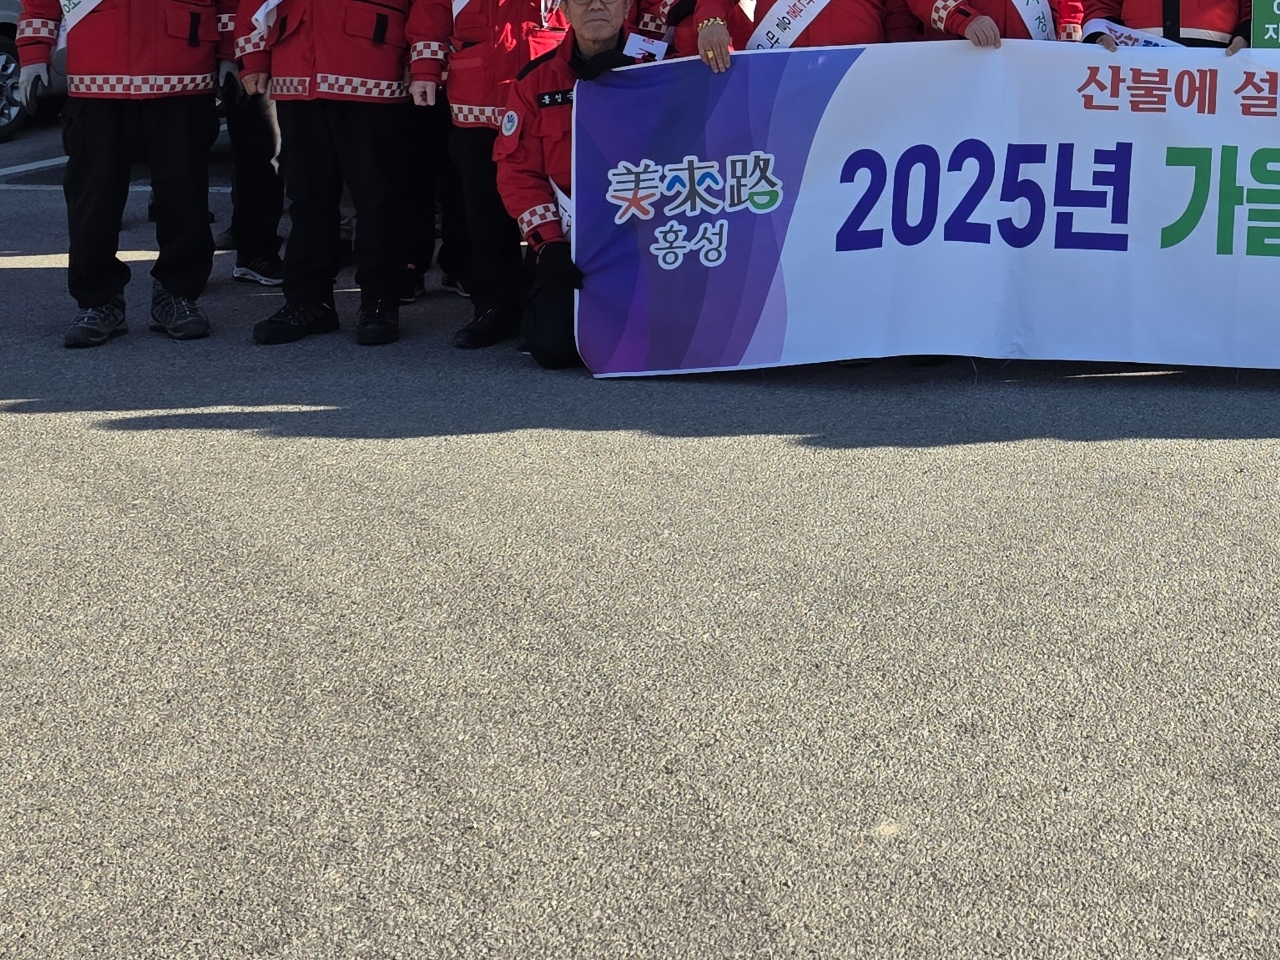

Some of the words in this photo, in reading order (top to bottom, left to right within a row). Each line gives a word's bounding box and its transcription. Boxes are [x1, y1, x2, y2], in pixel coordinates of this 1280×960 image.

[1077, 64, 1218, 115] 산불에
[835, 138, 1134, 252] 2025년
[652, 222, 728, 267] 홍성
